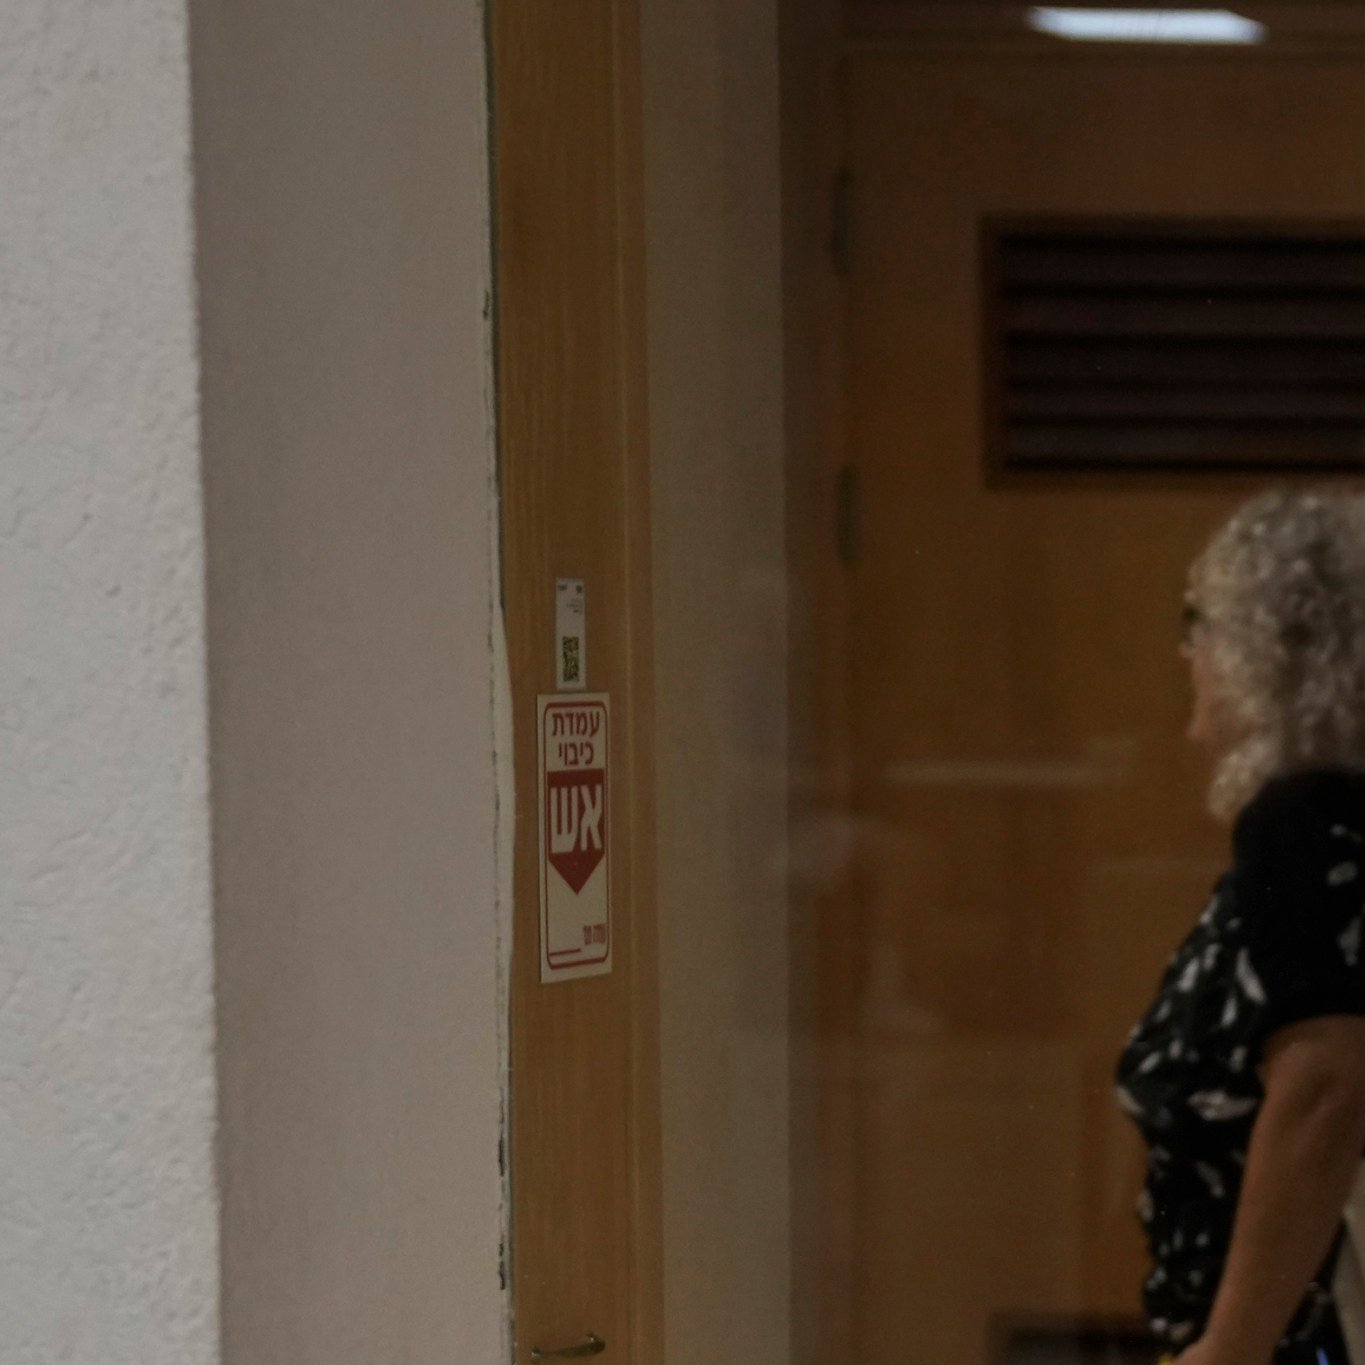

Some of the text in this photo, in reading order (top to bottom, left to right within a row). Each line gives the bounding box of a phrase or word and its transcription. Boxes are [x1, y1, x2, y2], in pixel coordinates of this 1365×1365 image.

[552, 712, 600, 737] עמדת
[558, 741, 594, 765] כיבוי
[551, 784, 602, 854] אש
